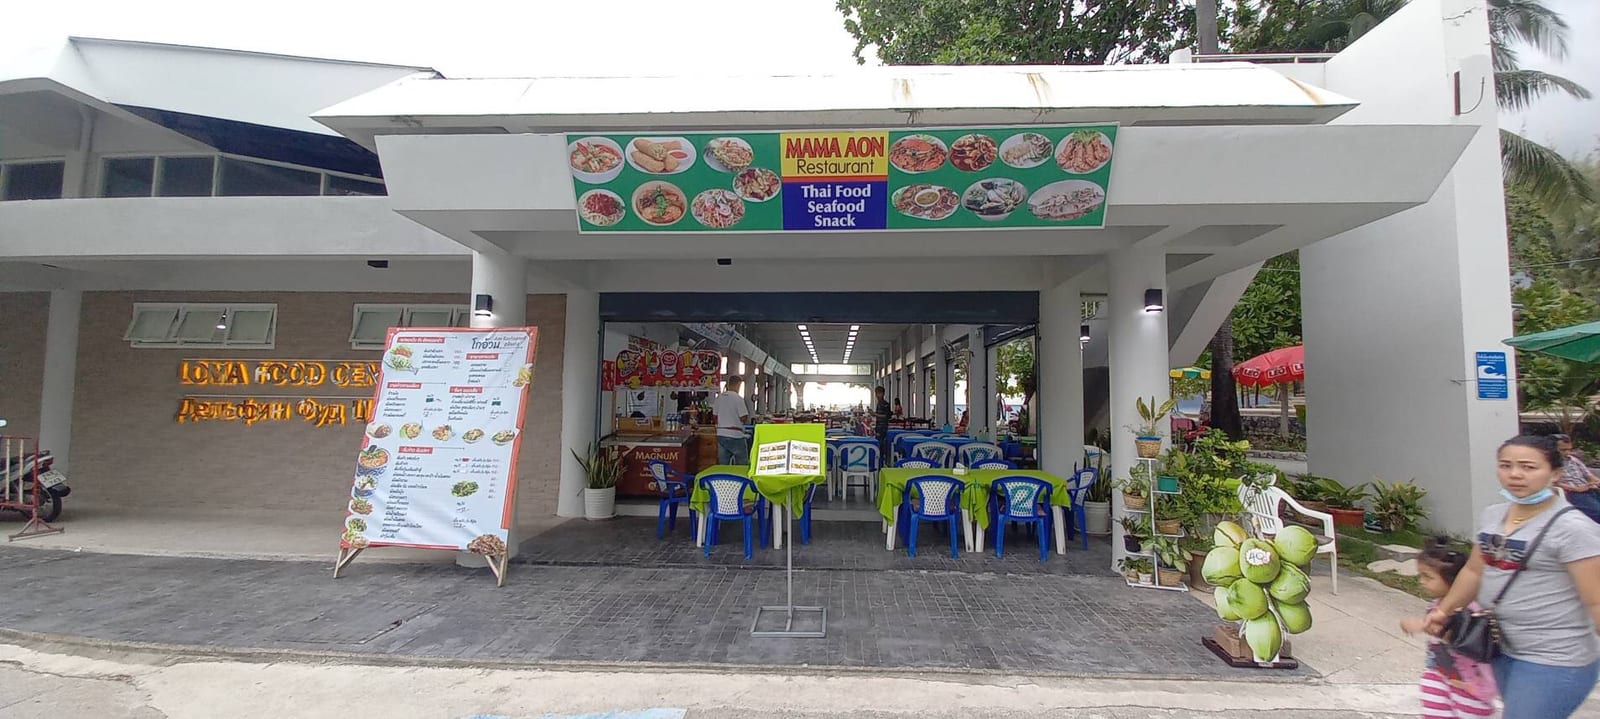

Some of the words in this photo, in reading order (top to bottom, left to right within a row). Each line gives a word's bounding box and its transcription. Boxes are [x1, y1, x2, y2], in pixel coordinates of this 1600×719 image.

[785, 137, 841, 158] MAMA
[844, 136, 885, 158] AON
[796, 159, 874, 174] Restaurant
[801, 184, 831, 198] Thai
[835, 184, 871, 198] Food
[807, 199, 865, 213] Seafood
[814, 214, 856, 227] Snack
[254, 360, 326, 386] FOOD
[1244, 368, 1259, 377] LEO
[1268, 367, 1286, 377] LEO
[635, 451, 679, 460] MAGNUM
[849, 445, 868, 467] 2
